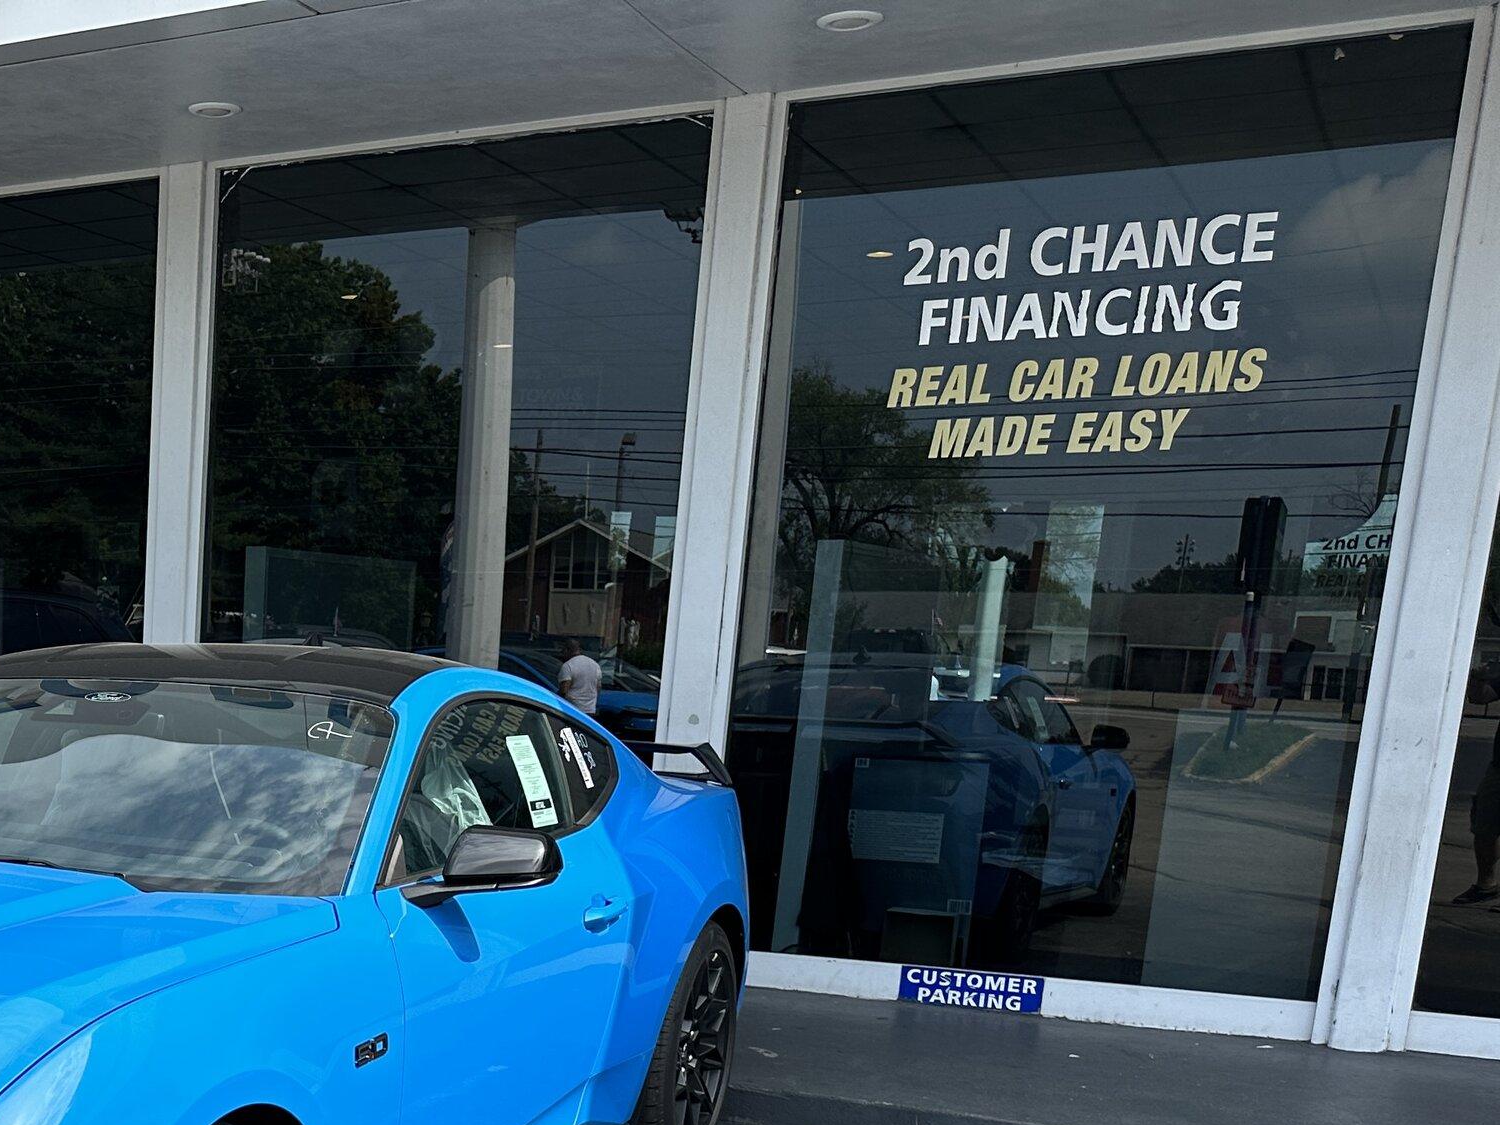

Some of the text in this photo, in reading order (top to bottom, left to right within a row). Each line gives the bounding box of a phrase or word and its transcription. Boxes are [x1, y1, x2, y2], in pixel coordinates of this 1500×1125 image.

[903, 211, 1279, 286] 2nd CHANCE
[918, 280, 1243, 346] FINANCING
[886, 347, 1268, 409] REAL CAR LOANS
[928, 408, 1190, 459] MADE EASY
[906, 968, 1037, 995] CUSTOMER
[917, 987, 1022, 1012] PARKING
